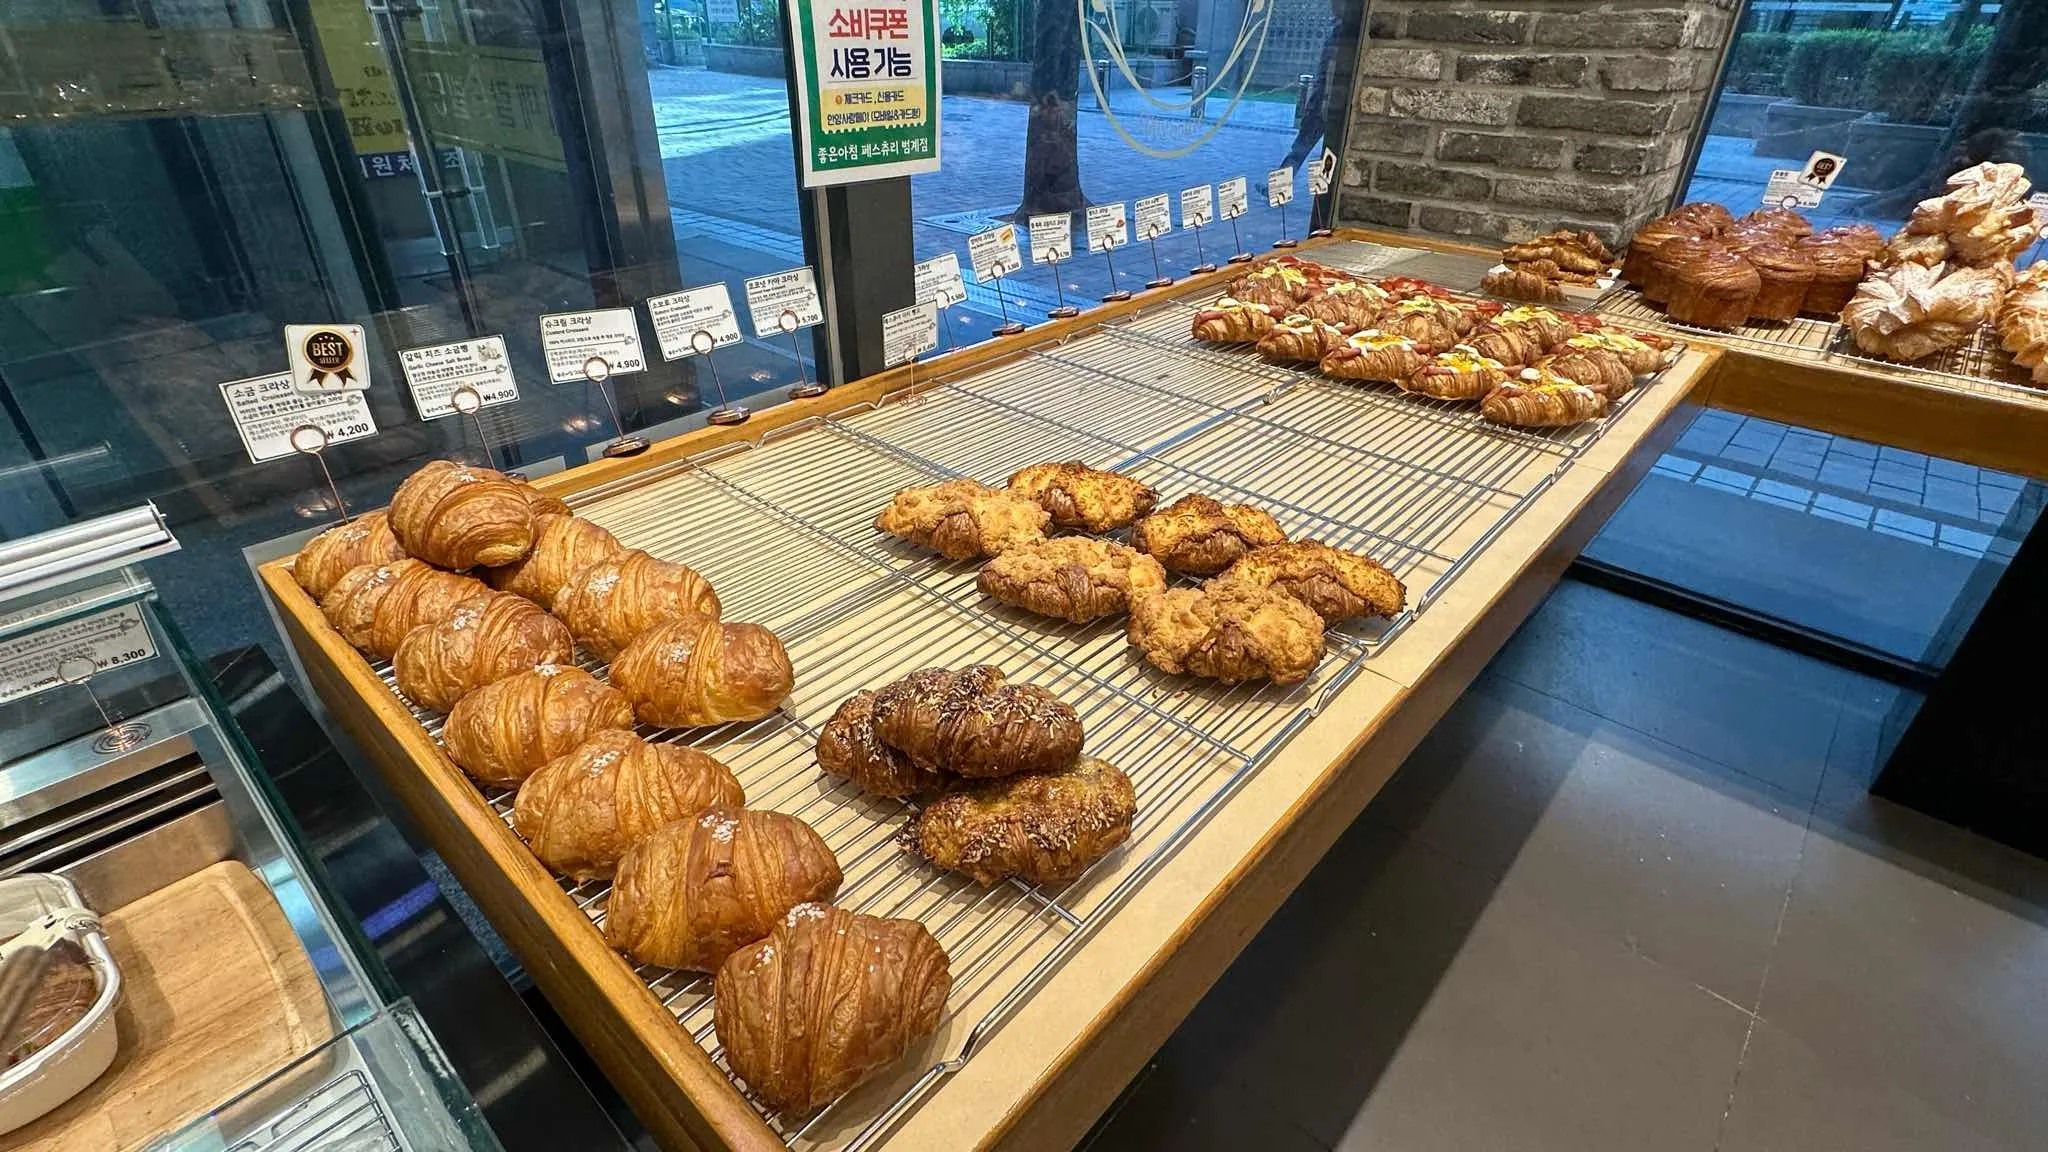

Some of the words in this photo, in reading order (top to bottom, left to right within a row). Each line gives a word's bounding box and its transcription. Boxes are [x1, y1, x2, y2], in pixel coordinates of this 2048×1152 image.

[829, 8, 909, 40] 소비쿠폰
[830, 47, 870, 79] 사용
[874, 47, 912, 78] 가능
[817, 144, 859, 164] 좋은아침
[861, 140, 899, 158] 페스츄리
[901, 138, 928, 155] 범계점
[781, 273, 799, 283] 크라상
[653, 299, 670, 308] 소보로
[672, 295, 690, 304] 크라상
[545, 319, 567, 328] 슈크림
[570, 316, 591, 325] 크라상
[720, 332, 738, 342] 4,900
[312, 342, 343, 356] BEST
[405, 352, 422, 362] 갈릭
[425, 349, 441, 357] 치즈
[445, 344, 468, 354] 소금빵
[617, 359, 640, 368] 4,900
[234, 386, 255, 398] 소금
[259, 379, 290, 392] 크라상
[483, 389, 514, 401] ₩4,900
[338, 423, 368, 436] 4,200
